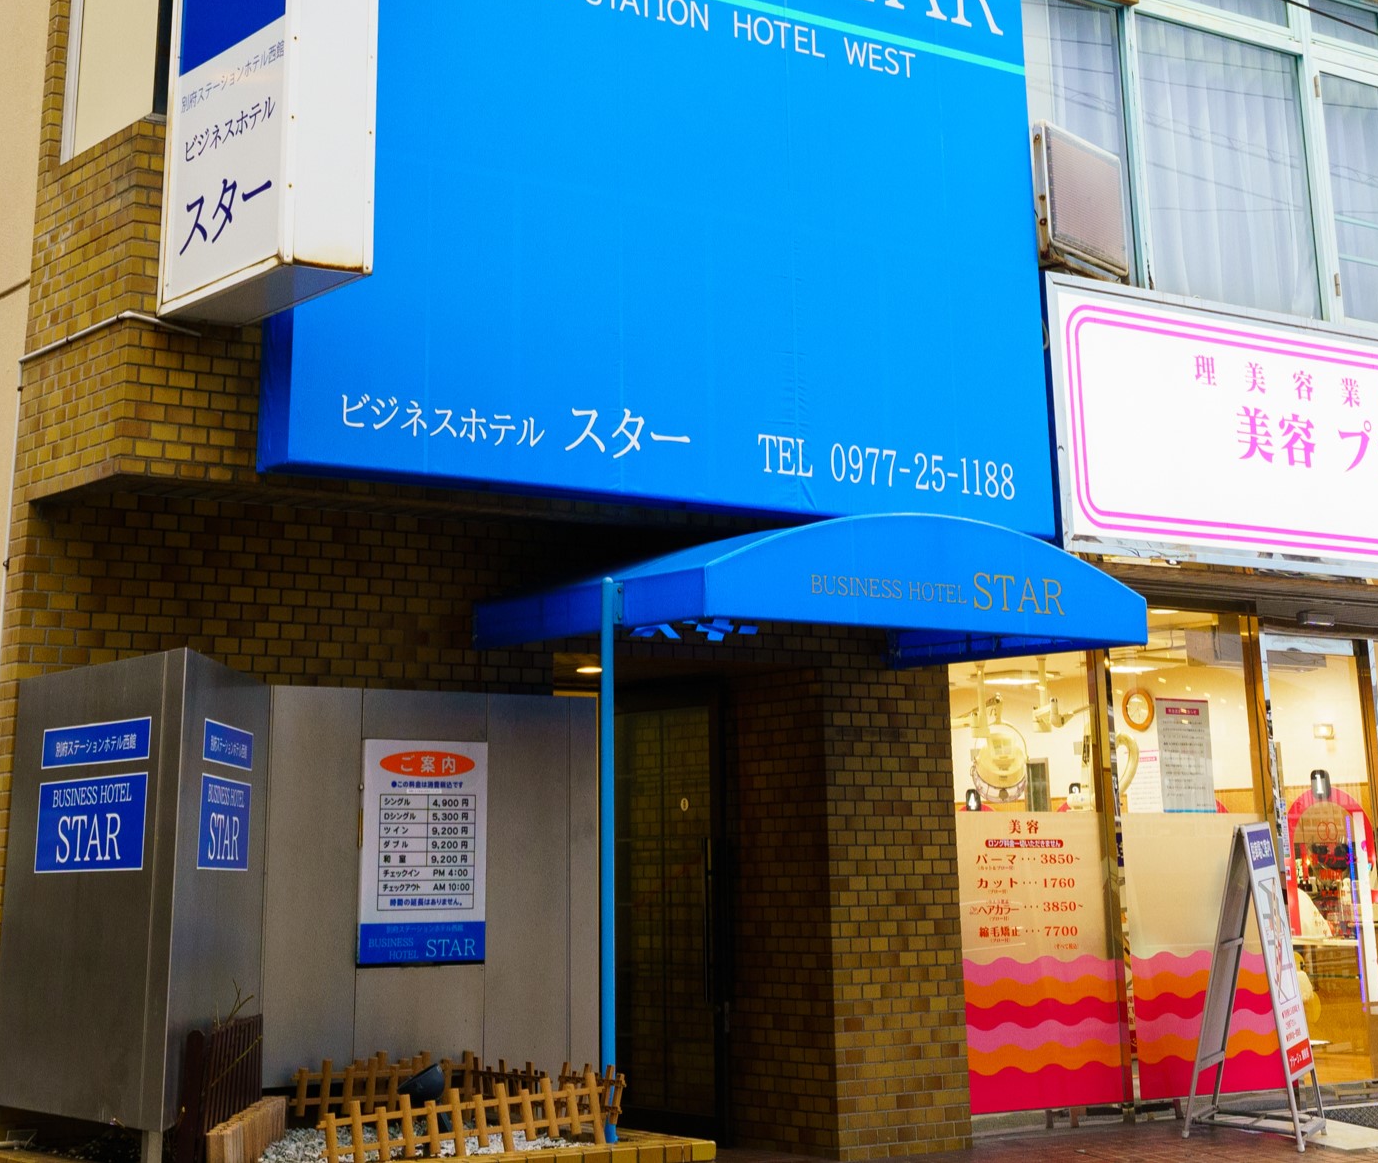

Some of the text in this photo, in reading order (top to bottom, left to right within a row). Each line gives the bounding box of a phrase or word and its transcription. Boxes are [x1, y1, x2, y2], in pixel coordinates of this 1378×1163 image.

[733, 10, 826, 59] HOTEL
[842, 35, 916, 79] WEST
[184, 95, 276, 163] ビジネスホテル
[179, 177, 273, 257] スター
[339, 392, 692, 460] ビジネスホテル スター
[1237, 405, 1316, 470] 美容
[758, 433, 1016, 501] TEL 0977-25-1188
[810, 571, 1065, 617] BUSINESS HOTEL STAR
[55, 733, 138, 758] 別府ステーションホテル西館
[401, 755, 456, 773] ご案内
[52, 783, 132, 808] BUSINESS HOTEL
[384, 798, 411, 806] シングル
[55, 813, 121, 864] STAR
[208, 812, 240, 861] STAR
[1009, 819, 1039, 834] 美容
[382, 869, 420, 878] チェックイン
[977, 877, 1075, 888] カット 1760
[382, 883, 421, 892] チェックアウト
[368, 937, 414, 948] BUSINESS
[1044, 926, 1078, 937] 7700
[389, 949, 419, 960] HOTEL
[425, 938, 476, 958] STAR
